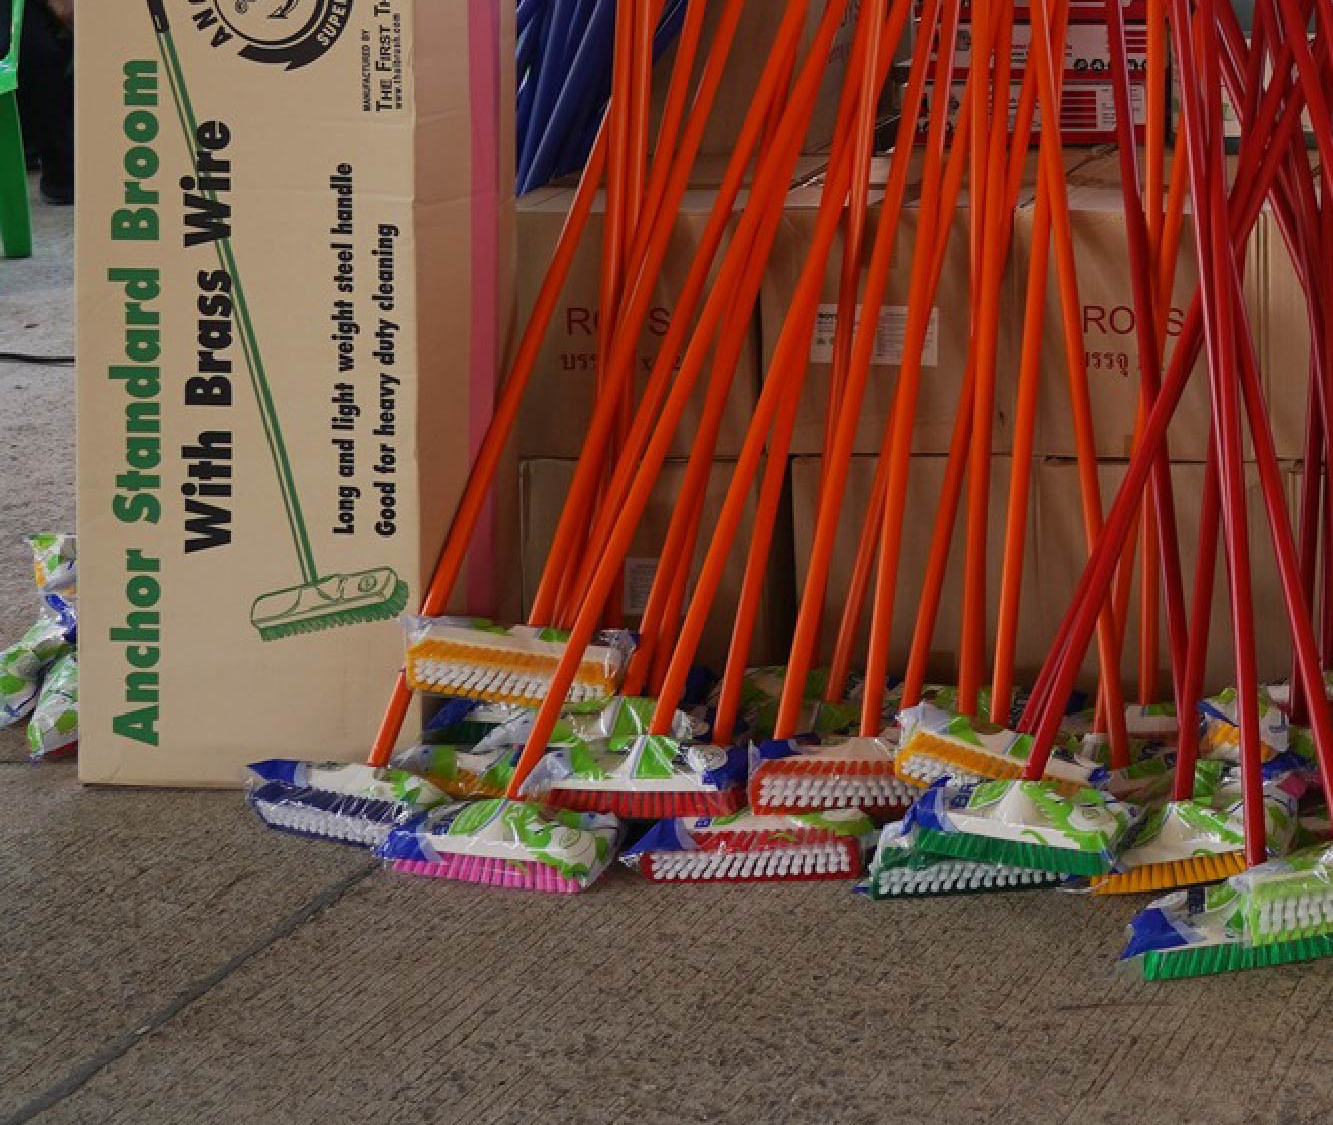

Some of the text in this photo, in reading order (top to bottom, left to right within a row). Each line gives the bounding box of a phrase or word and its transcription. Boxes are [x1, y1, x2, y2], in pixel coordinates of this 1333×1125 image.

[107, 58, 161, 747] Anchor Standard Broom
[179, 119, 233, 554] With Brass Wire
[329, 162, 361, 536] Long and light weight steel handle
[371, 223, 400, 538] Good for heavy duty cleaning
[1083, 305, 1185, 336] ROS
